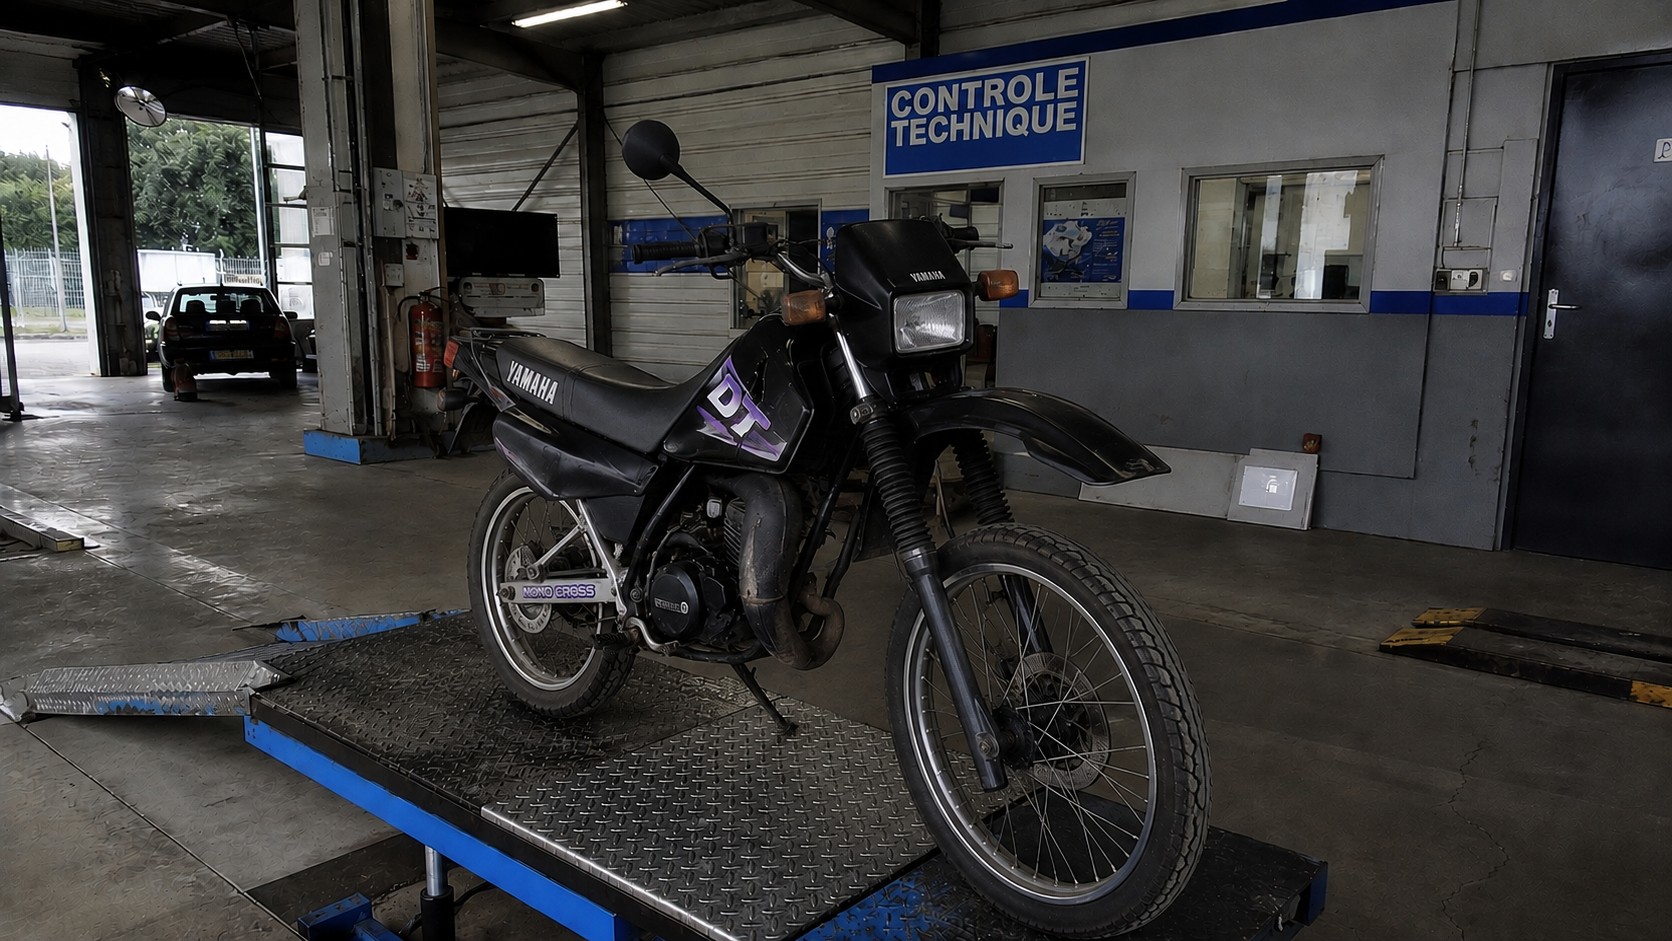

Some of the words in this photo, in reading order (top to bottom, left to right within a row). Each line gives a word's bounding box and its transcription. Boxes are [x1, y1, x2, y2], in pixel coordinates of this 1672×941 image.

[891, 67, 1079, 118] CONTROLE
[891, 101, 1077, 147] TECHNIQUE
[910, 270, 946, 282] YAMAHA
[507, 361, 558, 404] YAMAHA
[707, 373, 771, 437] DT
[523, 586, 553, 598] MONO
[555, 584, 596, 598] CROSS
